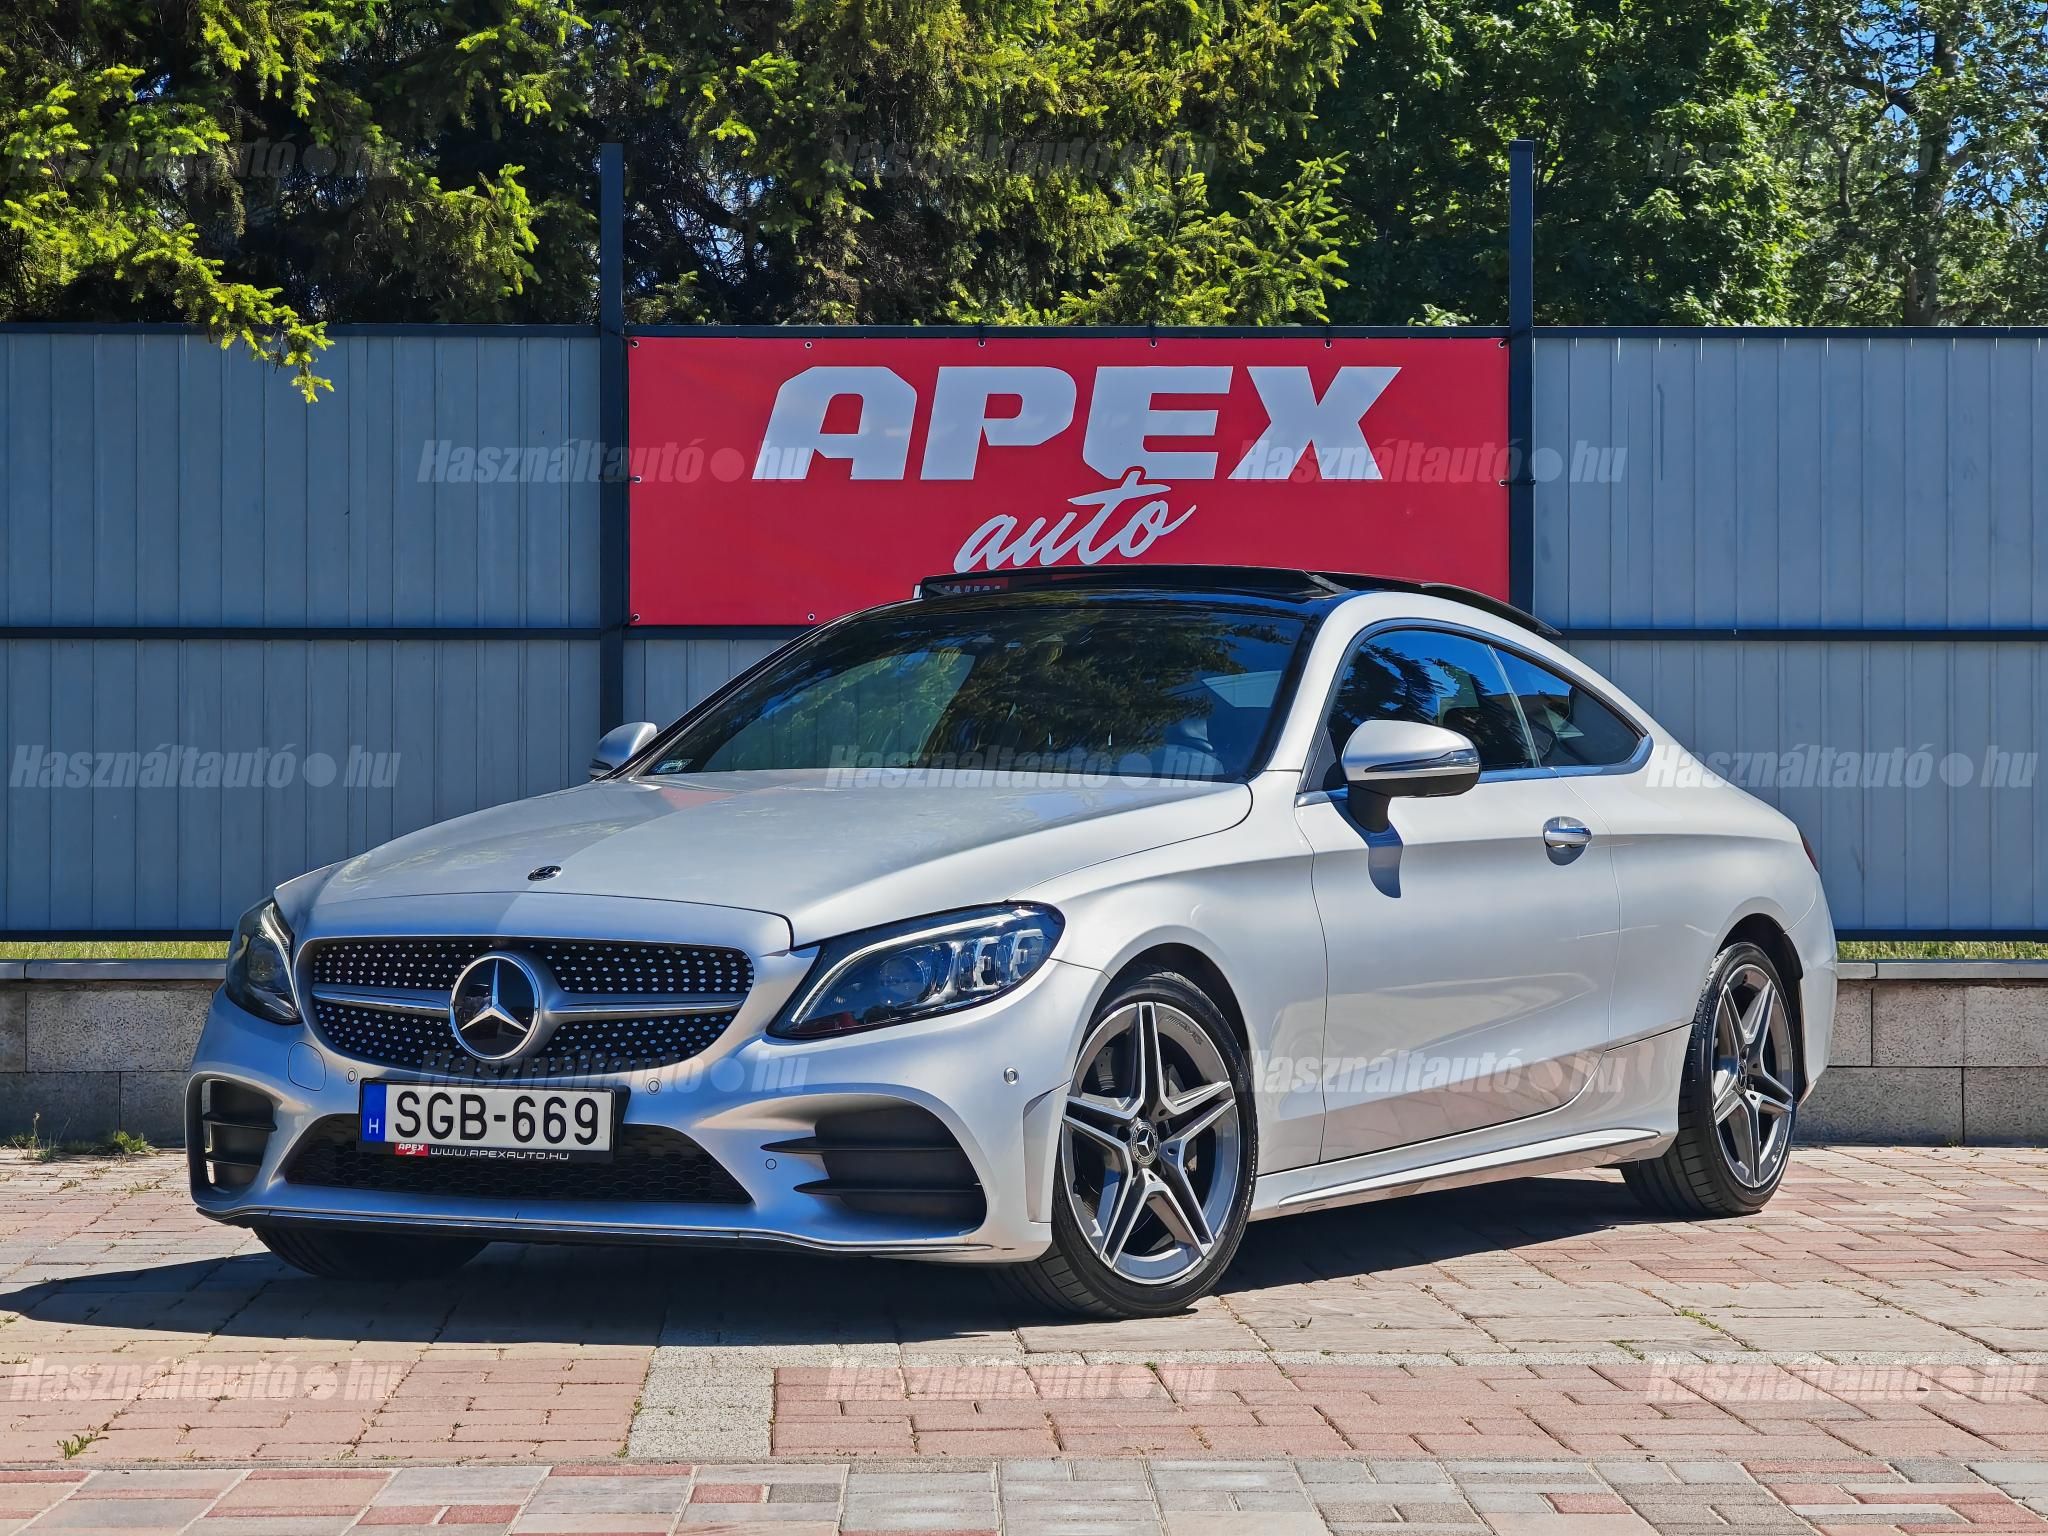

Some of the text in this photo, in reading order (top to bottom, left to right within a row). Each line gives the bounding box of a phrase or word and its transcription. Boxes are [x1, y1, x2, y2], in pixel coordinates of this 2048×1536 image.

[752, 365, 1402, 482] APEX
[953, 470, 1197, 574] auto
[368, 1090, 599, 1146] H SGB-669
[397, 1143, 425, 1152] APEX
